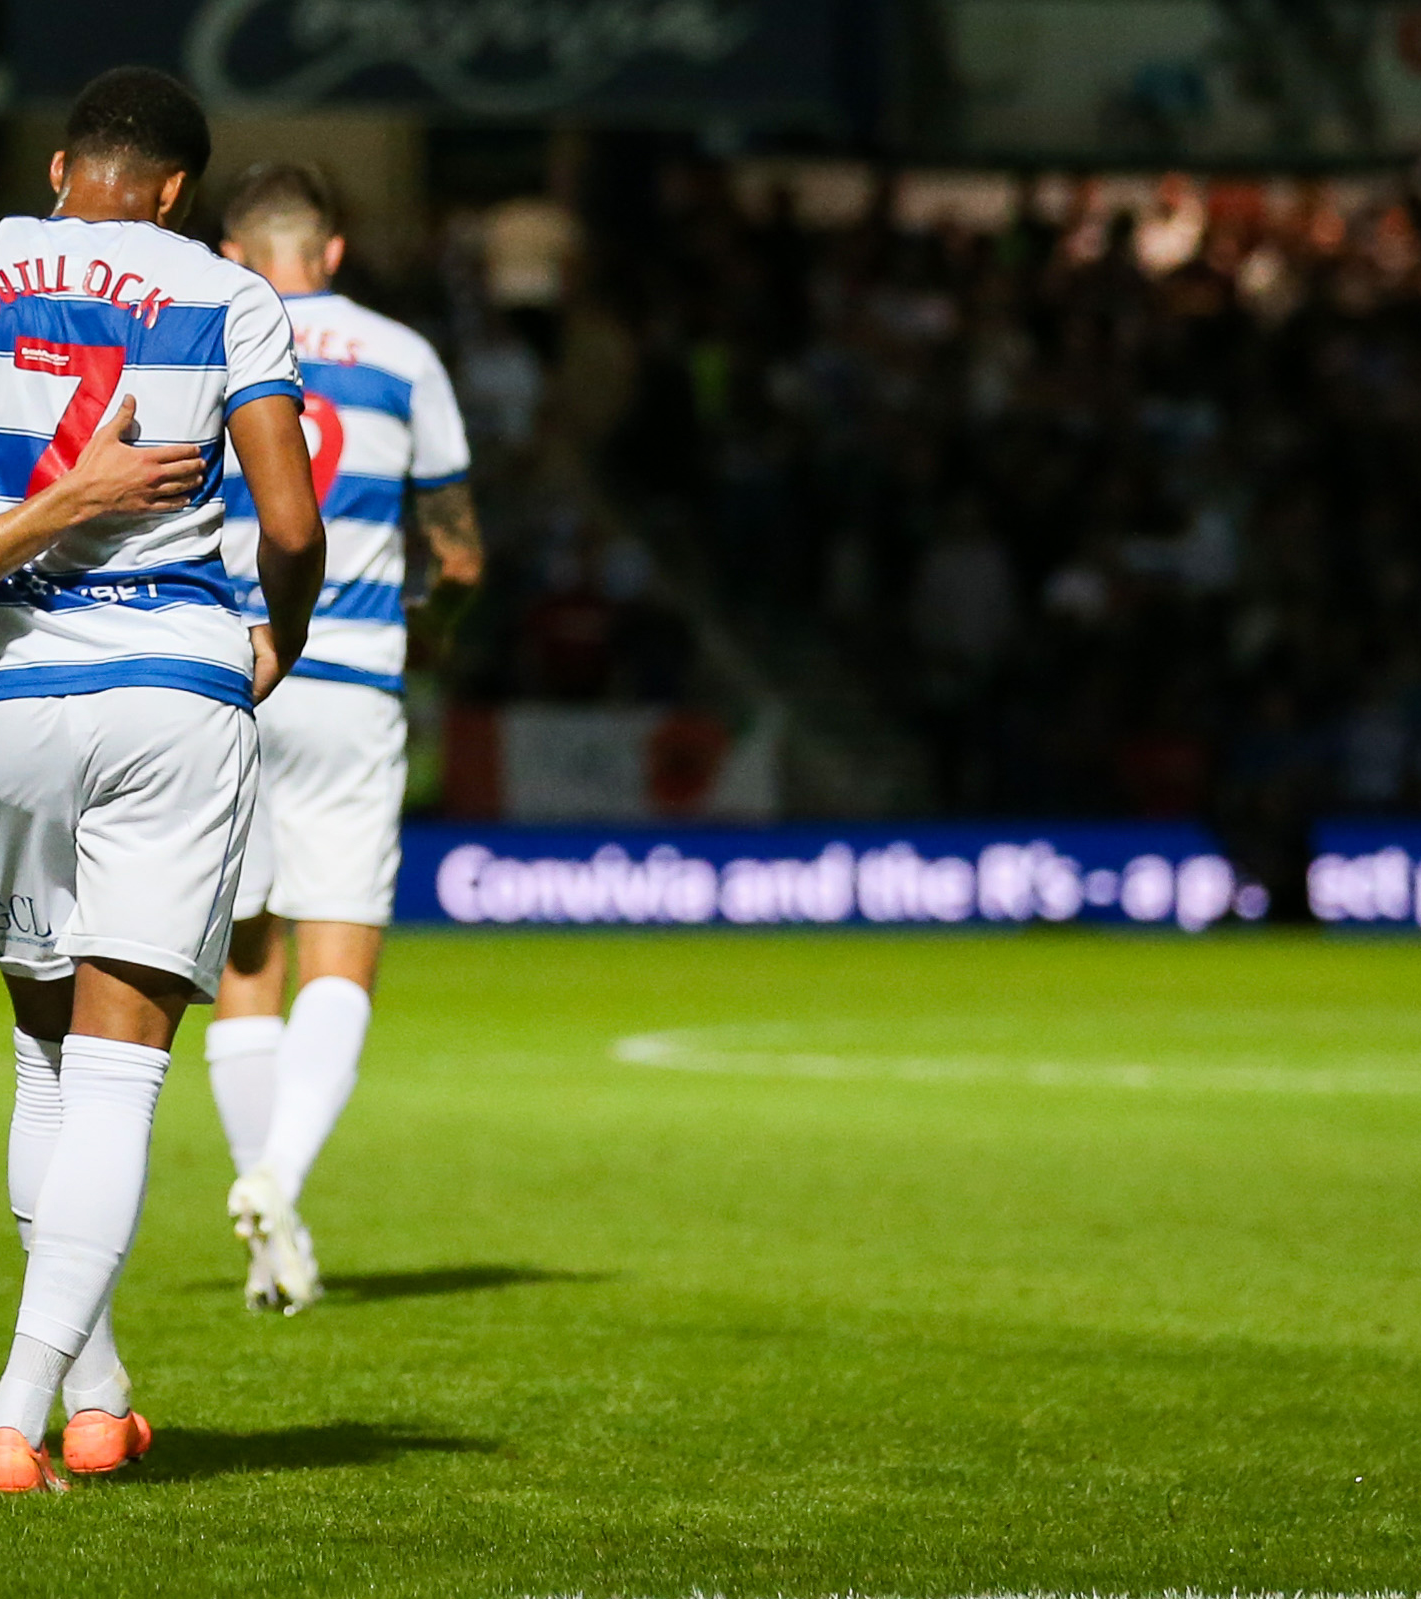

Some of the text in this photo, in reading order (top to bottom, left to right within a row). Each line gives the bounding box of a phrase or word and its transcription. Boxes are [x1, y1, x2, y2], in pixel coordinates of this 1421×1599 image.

[15, 336, 126, 500] 7
[436, 843, 717, 924] Convivia
[720, 841, 855, 924] and
[857, 840, 976, 923] the
